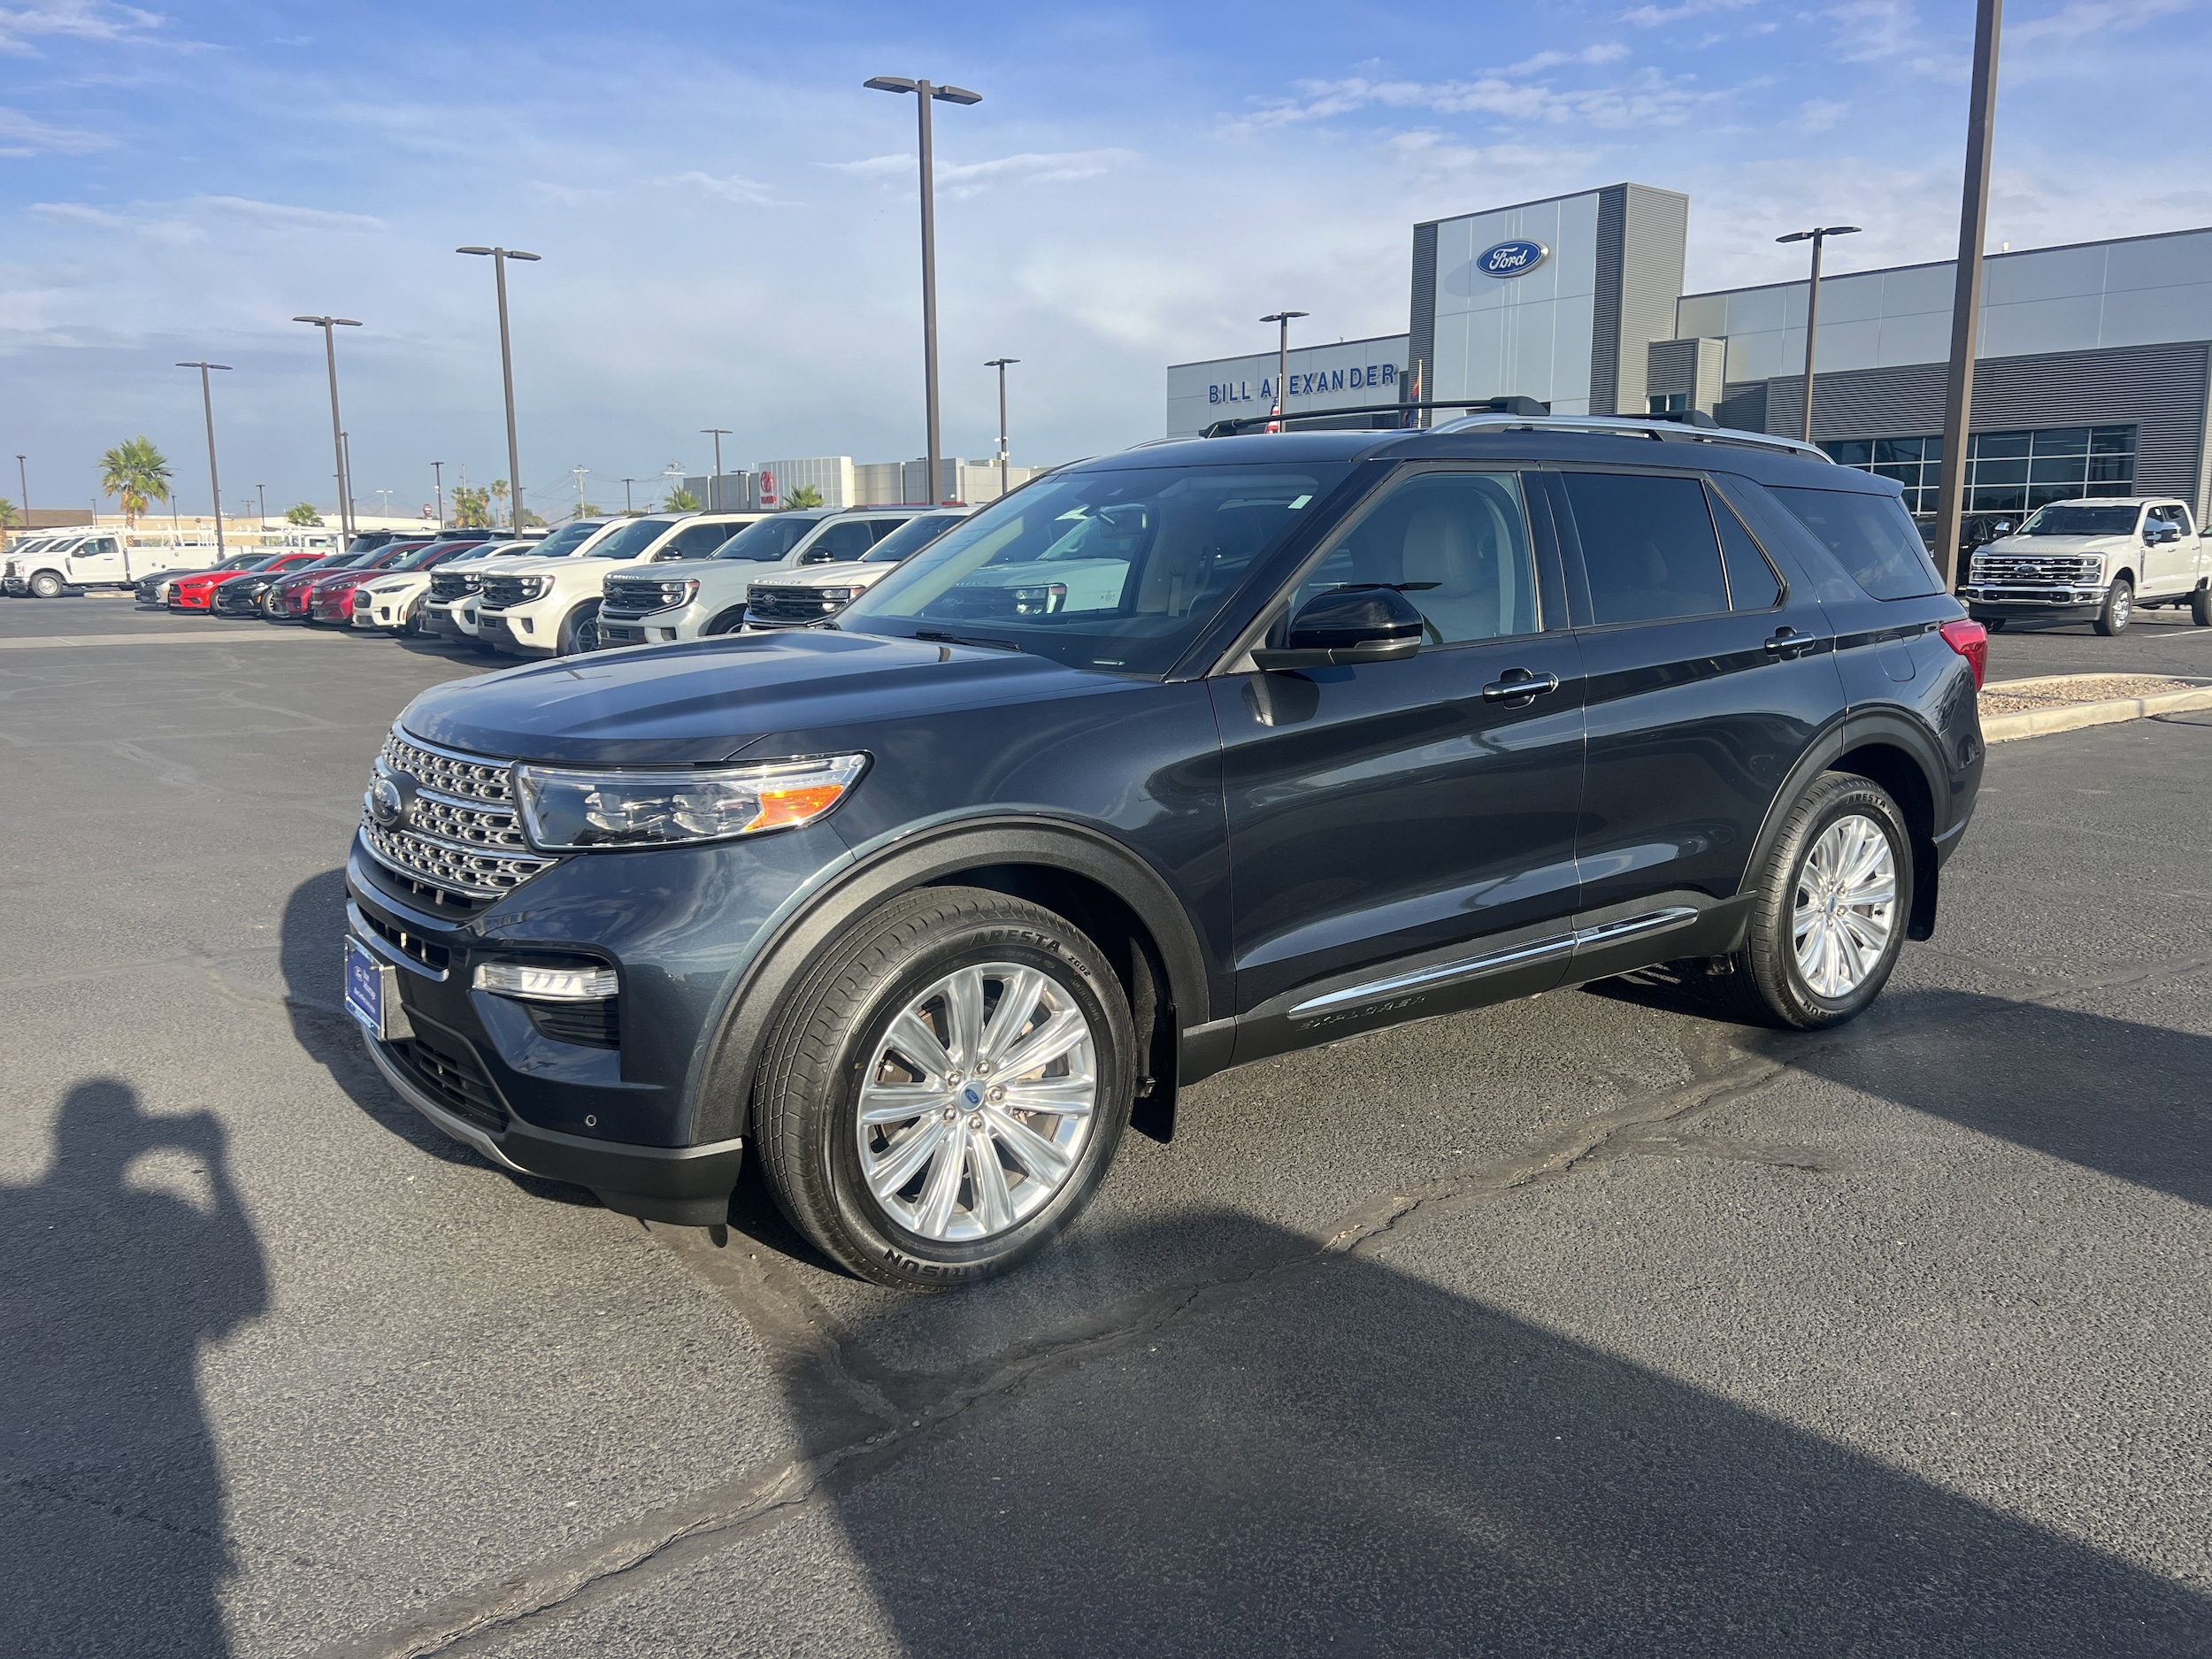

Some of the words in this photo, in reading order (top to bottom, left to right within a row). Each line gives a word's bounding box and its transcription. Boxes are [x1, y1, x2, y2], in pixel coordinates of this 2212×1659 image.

[1489, 247, 1528, 271] Ford
[1209, 381, 1251, 403] BILL
[970, 930, 1062, 953] ARESTA
[1068, 955, 1091, 977] ZG02
